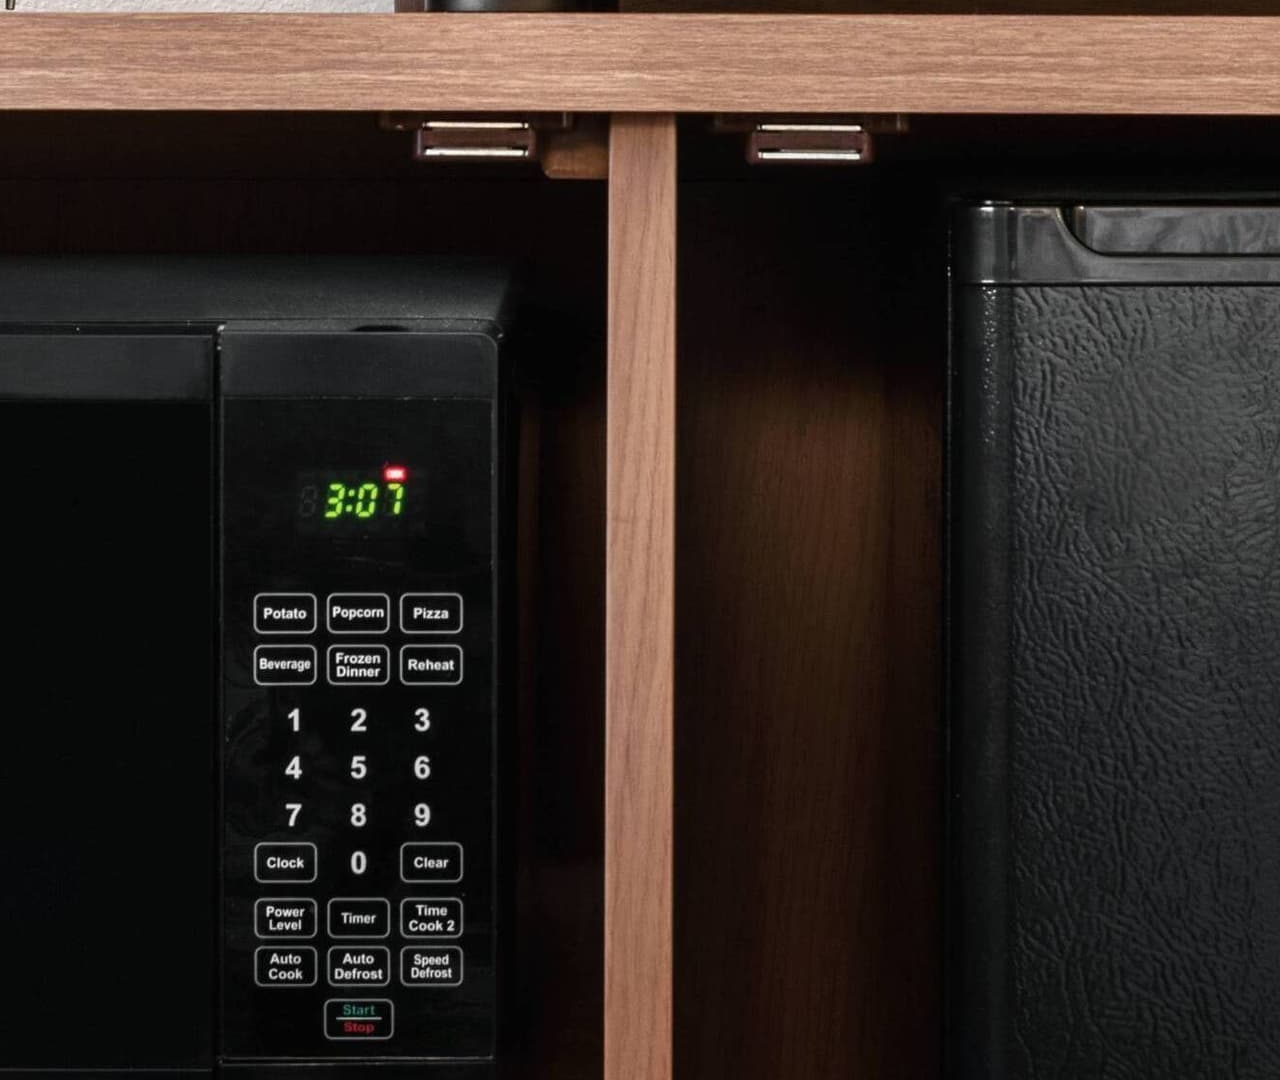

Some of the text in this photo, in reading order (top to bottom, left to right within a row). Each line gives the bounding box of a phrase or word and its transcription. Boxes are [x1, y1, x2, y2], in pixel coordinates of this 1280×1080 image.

[324, 482, 404, 519] 3:07
[263, 607, 307, 620] Potato
[332, 605, 385, 621] Popcorn
[413, 607, 449, 620] Pizza
[259, 657, 312, 673] Beverage
[335, 652, 381, 665] Frozen
[407, 658, 455, 671] Reheat
[336, 665, 381, 678] Dinner
[287, 707, 300, 732] 1
[350, 708, 367, 732] 2
[414, 707, 431, 732] 3
[284, 755, 303, 780] 4
[350, 755, 367, 780] 5
[413, 755, 431, 780] 6
[285, 803, 302, 827] 7
[350, 803, 367, 827] 8
[414, 803, 431, 827] 9
[266, 856, 305, 869] Clock
[350, 850, 367, 875] 0
[413, 856, 449, 869] Clear
[265, 905, 305, 918] Power
[415, 904, 448, 917] Time
[268, 918, 302, 931] Level
[341, 911, 377, 925] Timer
[408, 919, 456, 932] Cook 2
[269, 952, 302, 965] Auto
[342, 952, 375, 965] Auto
[413, 953, 450, 967] Speed
[268, 967, 303, 980] Cook
[334, 967, 383, 980] Defrost
[410, 966, 453, 979] Defrost
[343, 1004, 375, 1016] Start
[343, 1021, 375, 1034] Stop
